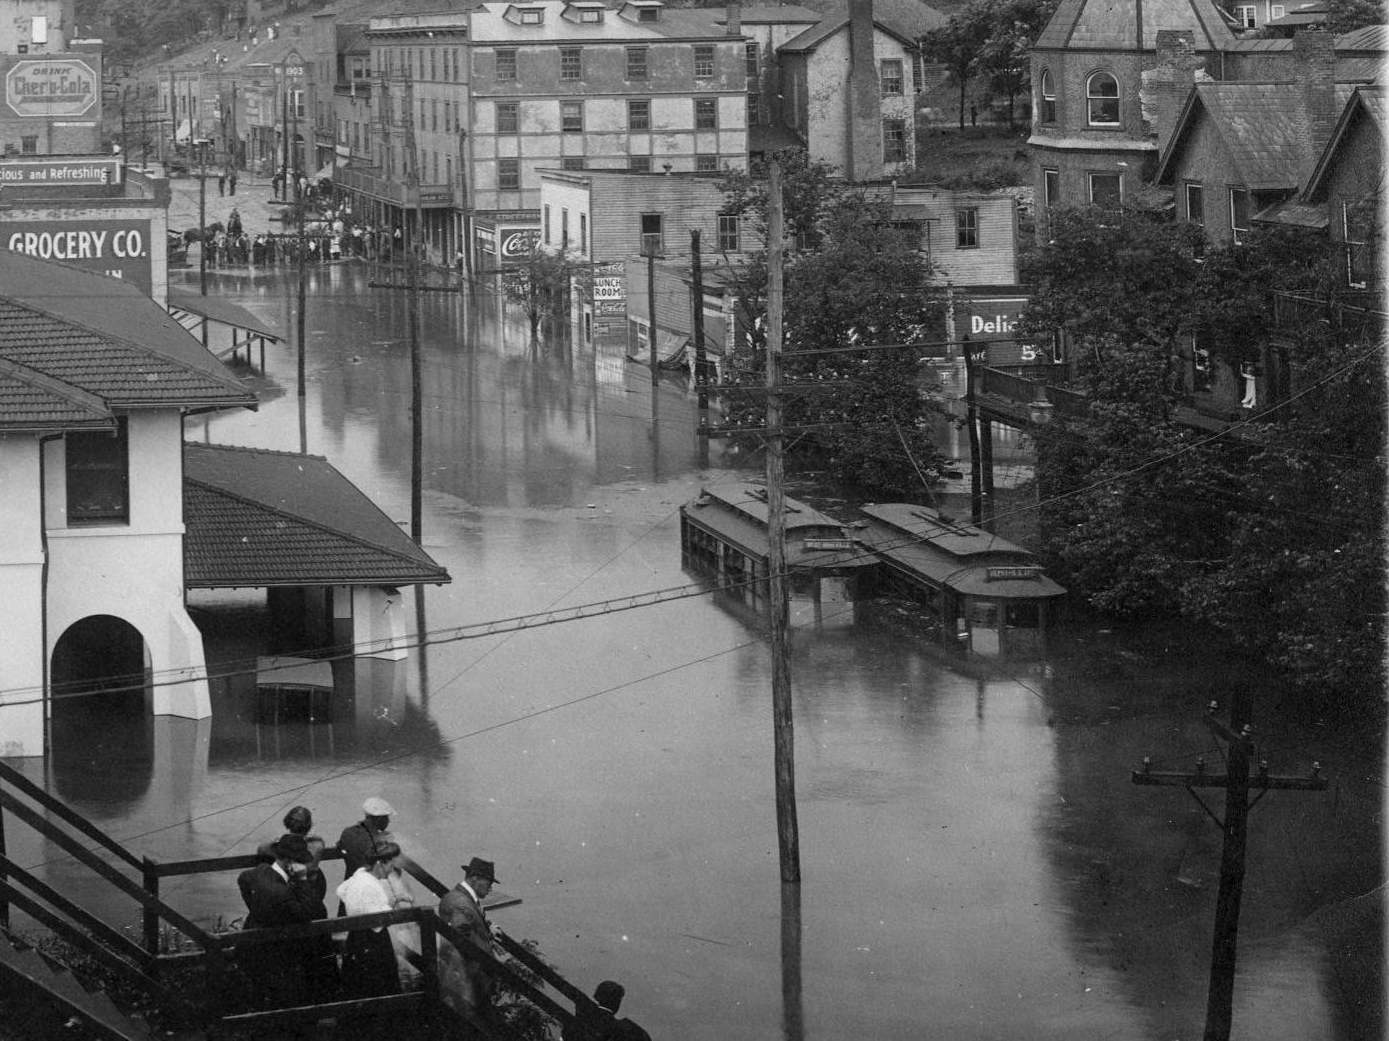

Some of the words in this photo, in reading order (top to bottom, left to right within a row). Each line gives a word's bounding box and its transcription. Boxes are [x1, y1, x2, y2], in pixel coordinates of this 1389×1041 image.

[32, 67, 71, 76] DRINK
[14, 75, 92, 95] Chero-Cola
[29, 169, 46, 179] and
[50, 166, 108, 182] Refreshing
[9, 231, 107, 258] GROCERY
[112, 230, 146, 257] CO.
[594, 278, 621, 287] LUNCH
[595, 288, 621, 297] ROOM
[971, 314, 1023, 334] Delic
